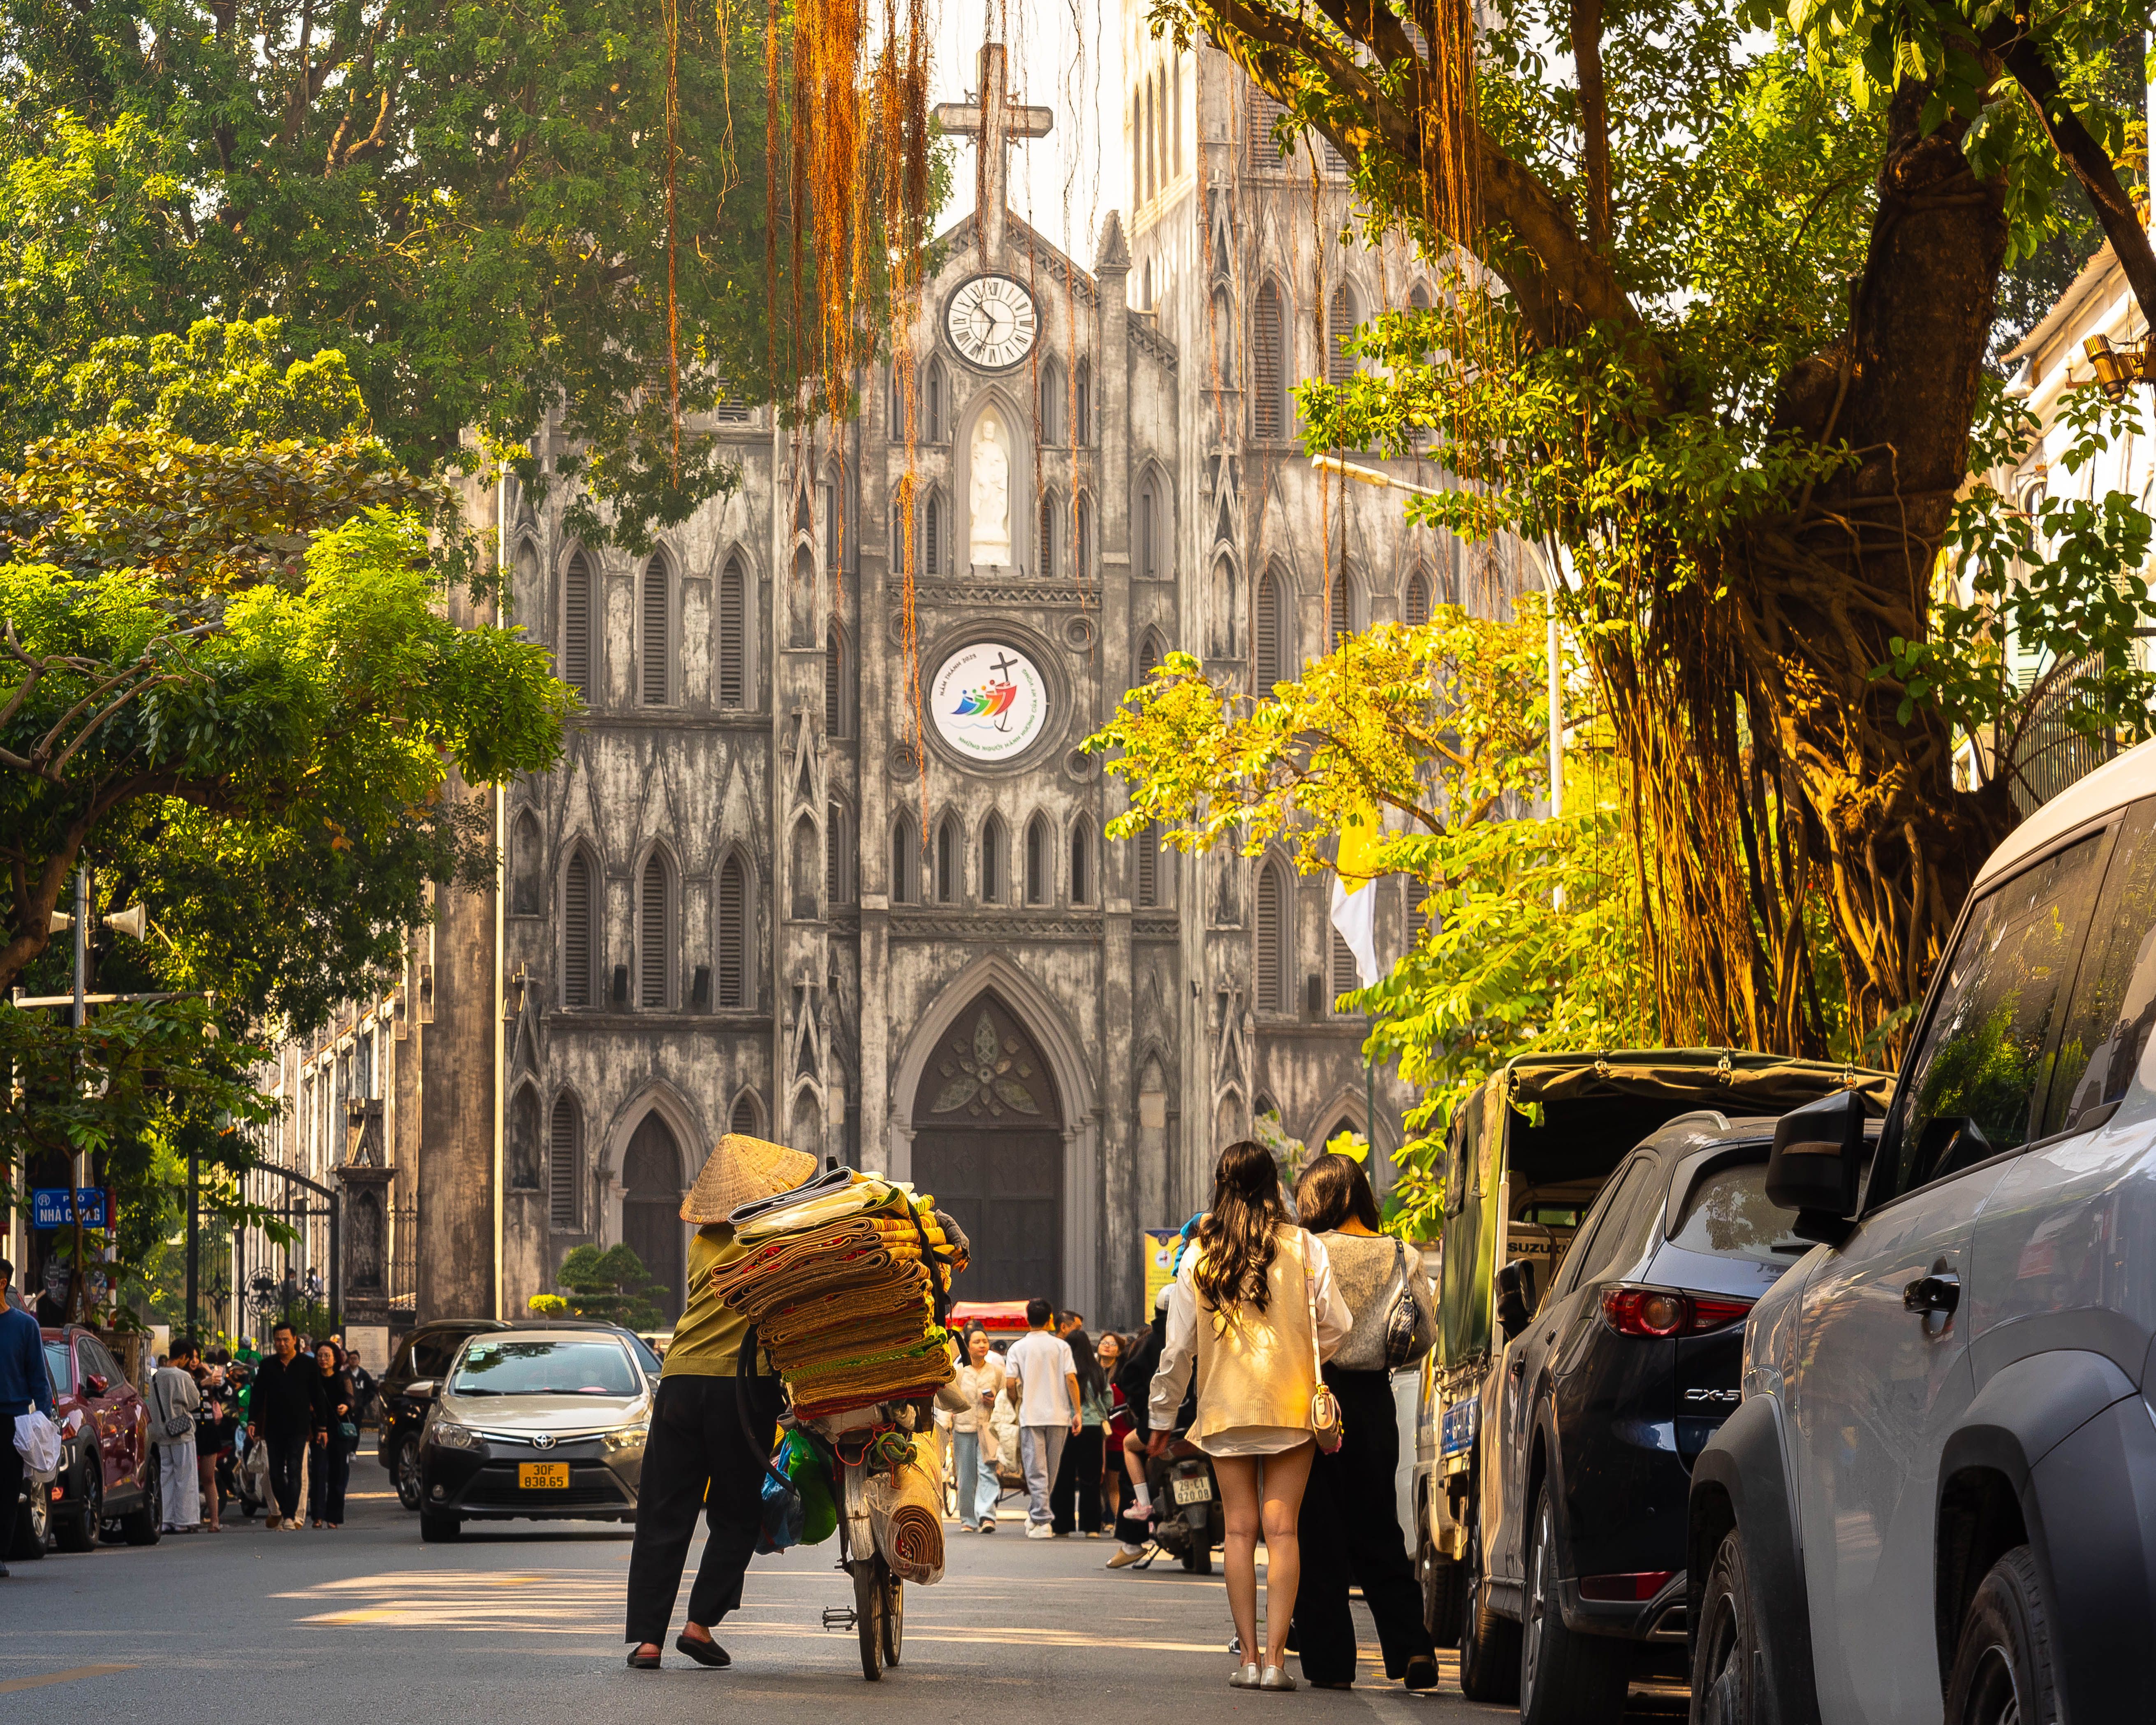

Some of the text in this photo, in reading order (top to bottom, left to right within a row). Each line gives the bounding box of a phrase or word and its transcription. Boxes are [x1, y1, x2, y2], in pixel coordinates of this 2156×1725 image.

[63, 1192, 84, 1202] PỐ
[40, 1206, 61, 1222] NHÀ
[1684, 1389, 1741, 1401] CX-5
[534, 1465, 554, 1475] 30F
[525, 1477, 563, 1487] 838.65
